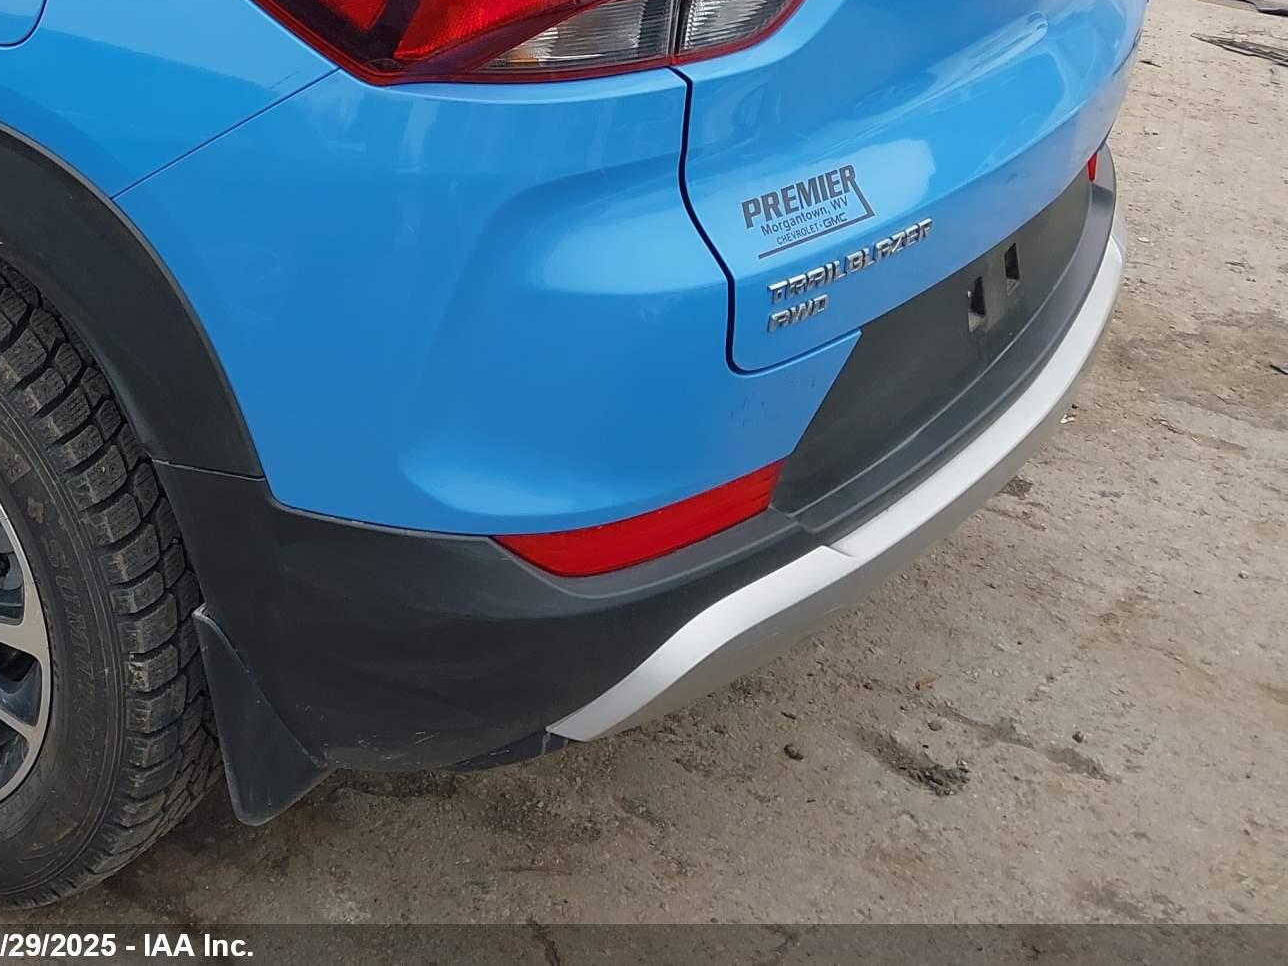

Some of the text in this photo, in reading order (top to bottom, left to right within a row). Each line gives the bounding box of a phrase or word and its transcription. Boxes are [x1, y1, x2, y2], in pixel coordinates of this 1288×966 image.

[741, 164, 857, 229] PREMIER
[760, 195, 849, 237] Morgantown, WV
[767, 218, 932, 304] TRAILBLAZER
[767, 293, 829, 332] AWD
